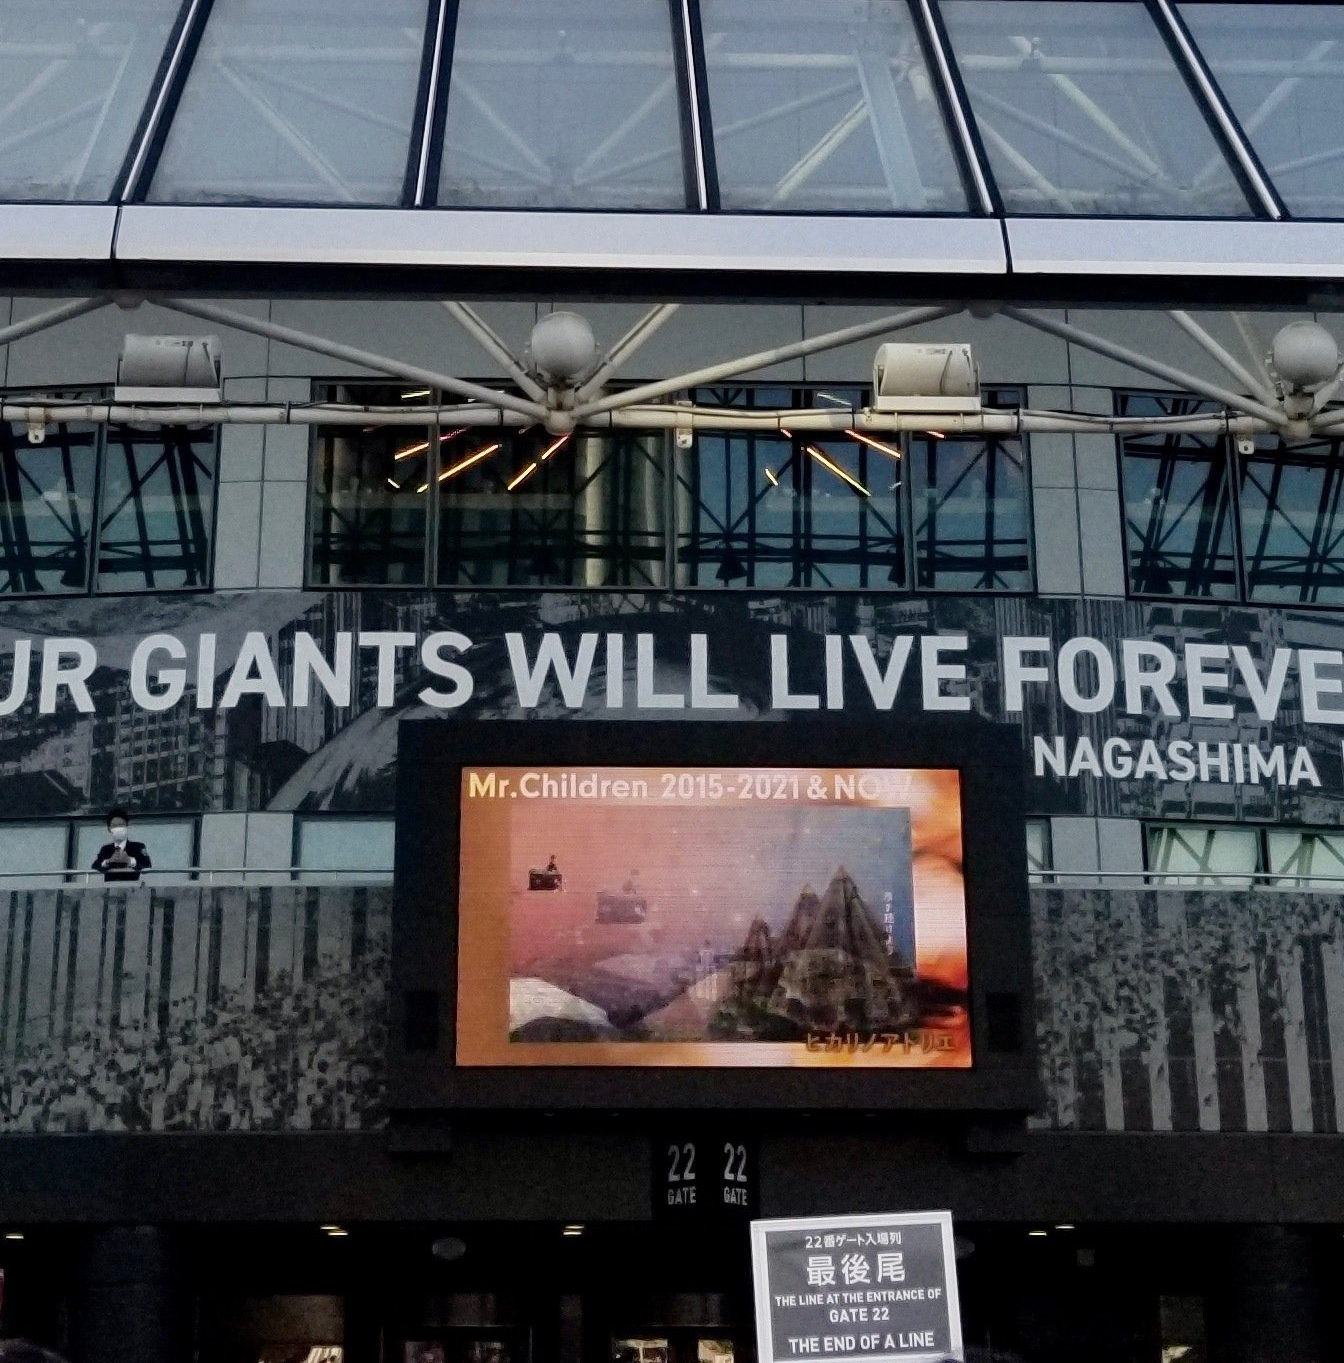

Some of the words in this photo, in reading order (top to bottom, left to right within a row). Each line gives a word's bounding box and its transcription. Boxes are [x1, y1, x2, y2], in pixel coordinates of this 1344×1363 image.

[130, 631, 474, 711] GIANTS
[505, 632, 739, 709] WILL
[771, 634, 971, 712] LIVE
[1034, 736, 1322, 788] NAGASHIMA
[469, 772, 648, 799] Mr.Children
[661, 773, 799, 800] 2015-2021
[807, 775, 828, 800] &
[834, 773, 912, 800] NO
[807, 1032, 956, 1054] ヒカリノアトリエ
[668, 1142, 696, 1182] 22
[724, 1142, 748, 1182] 22
[668, 1186, 697, 1205] GATE
[724, 1186, 748, 1206] GATE
[805, 1232, 902, 1249] 22番ゲート入場列
[806, 1252, 905, 1287] 最後尾
[775, 1295, 797, 1307] THE
[799, 1293, 824, 1306] LINE
[826, 1293, 841, 1305] AT
[842, 1291, 864, 1304] THE
[866, 1289, 924, 1302] ENTRANCE
[927, 1288, 942, 1300] OF
[829, 1308, 869, 1323] GATE
[872, 1307, 890, 1321] 22
[788, 1338, 820, 1354] THE
[824, 1336, 856, 1352] END
[860, 1335, 880, 1350] OF
[884, 1334, 896, 1349] A
[899, 1331, 935, 1348] LINE
